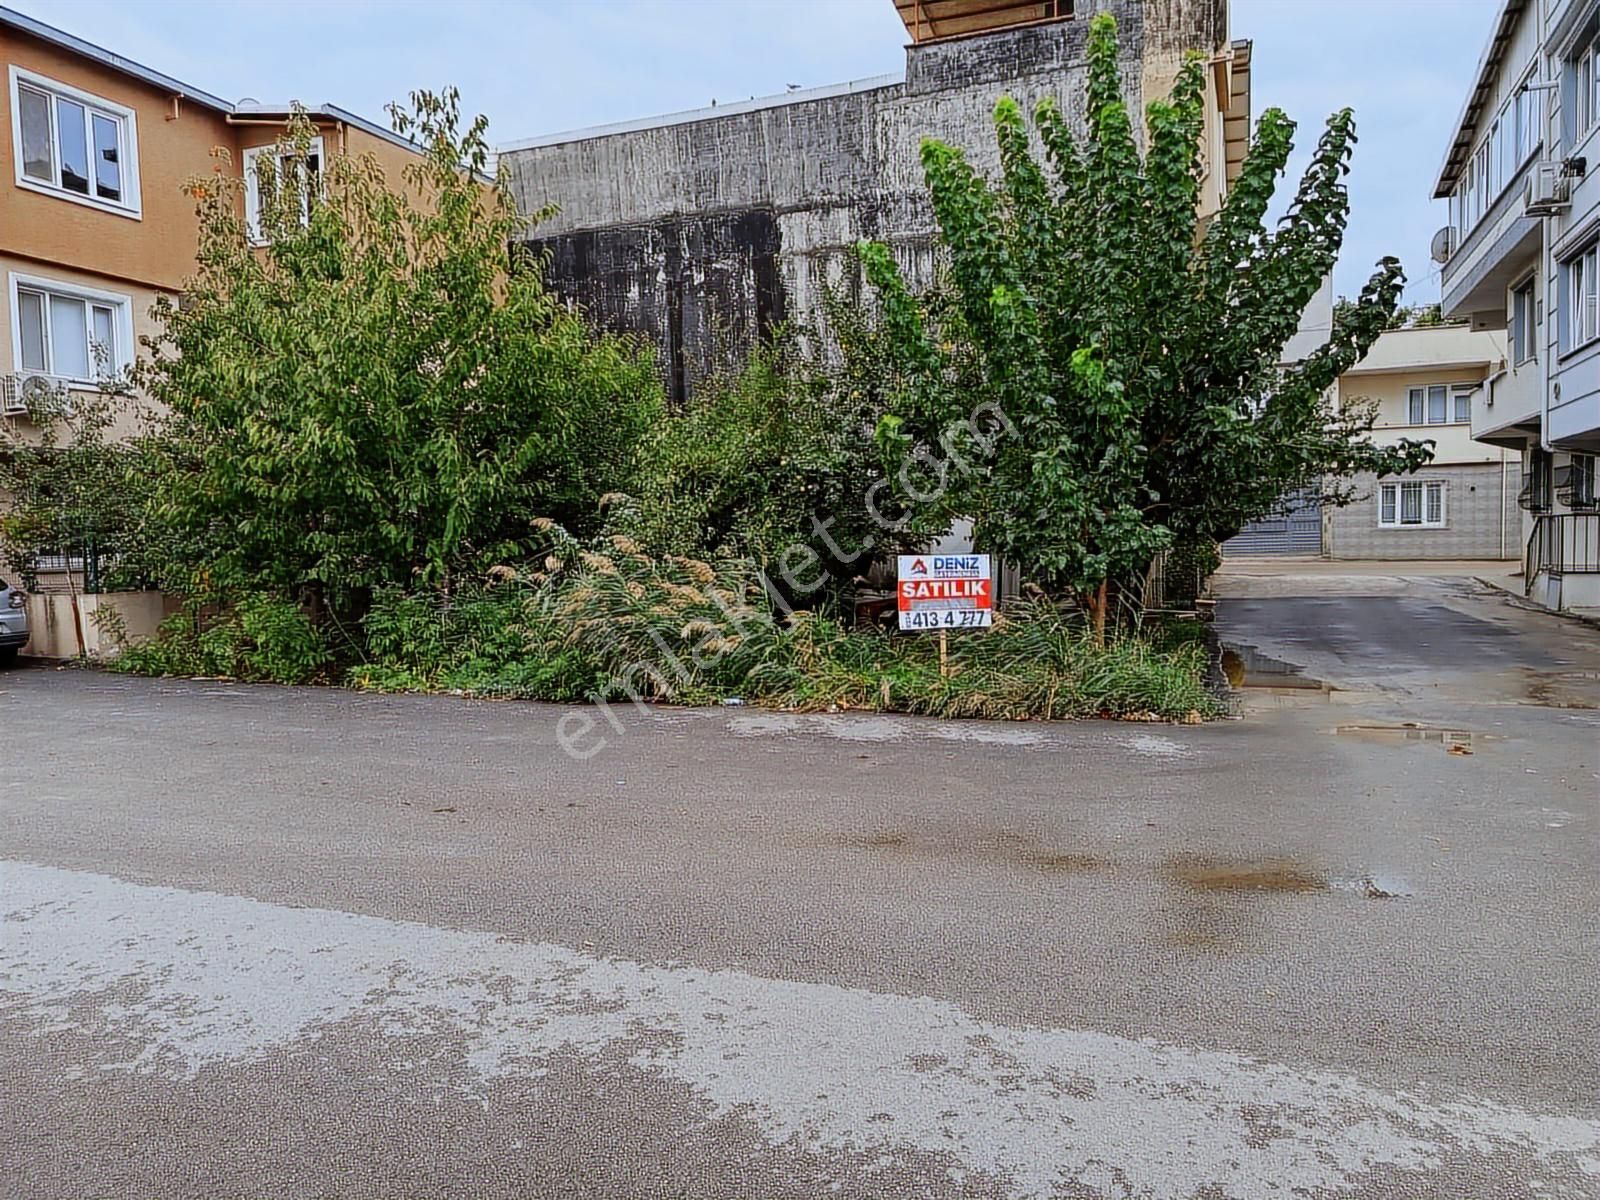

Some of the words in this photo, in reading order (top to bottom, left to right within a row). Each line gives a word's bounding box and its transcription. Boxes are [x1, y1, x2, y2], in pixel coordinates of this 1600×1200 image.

[902, 581, 987, 598] SATILIK
[912, 612, 938, 627] 413
[944, 611, 954, 626] 4
